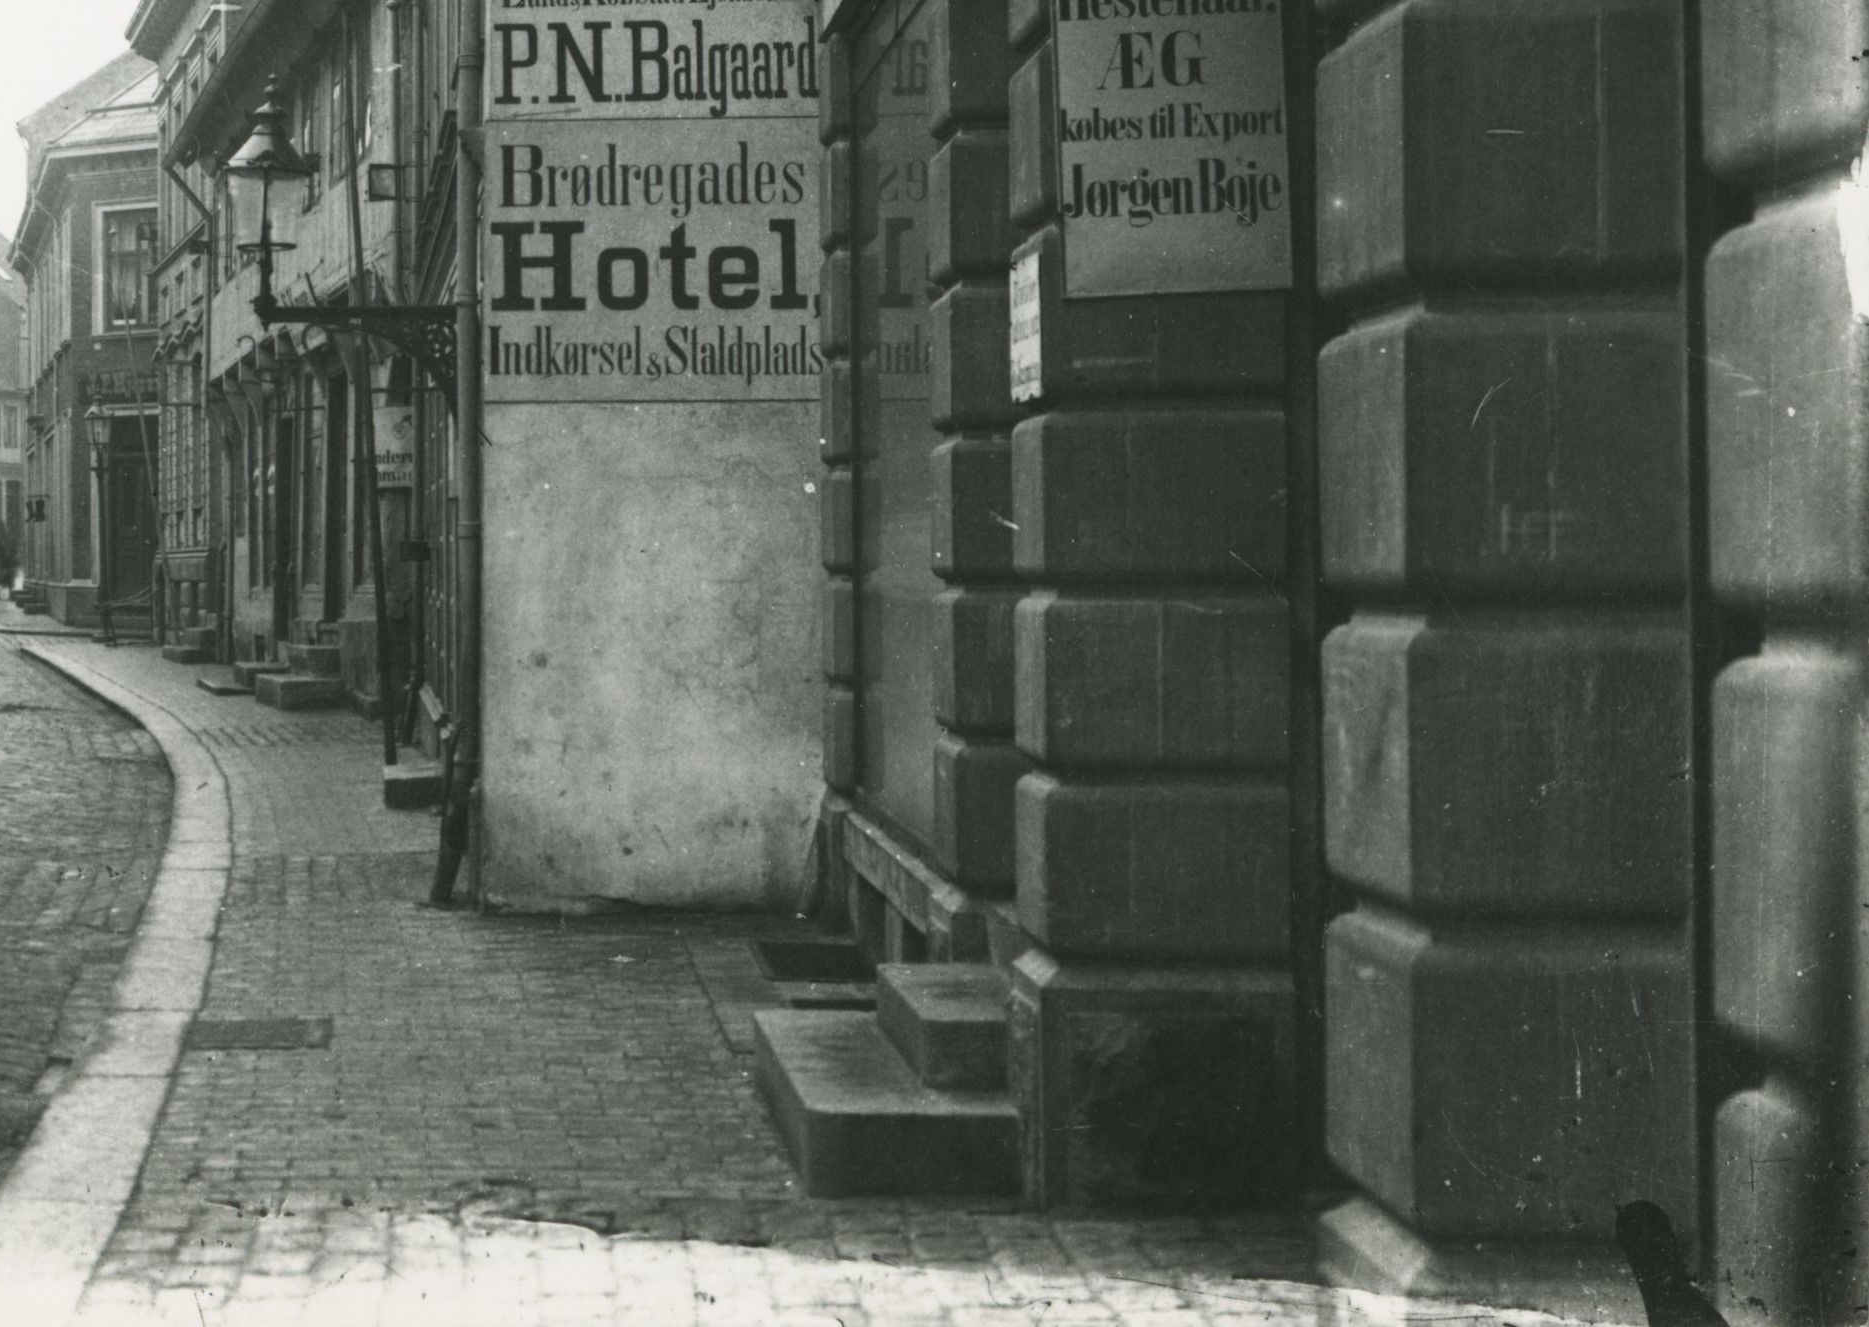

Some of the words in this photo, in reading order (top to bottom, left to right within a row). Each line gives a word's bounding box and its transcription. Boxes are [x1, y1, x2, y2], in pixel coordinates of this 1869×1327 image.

[1096, 29, 1207, 91] ÆG
[1148, 102, 1176, 139] til
[1182, 101, 1283, 143] Export
[500, 140, 805, 218] Brødregades
[1196, 156, 1282, 228] Boje
